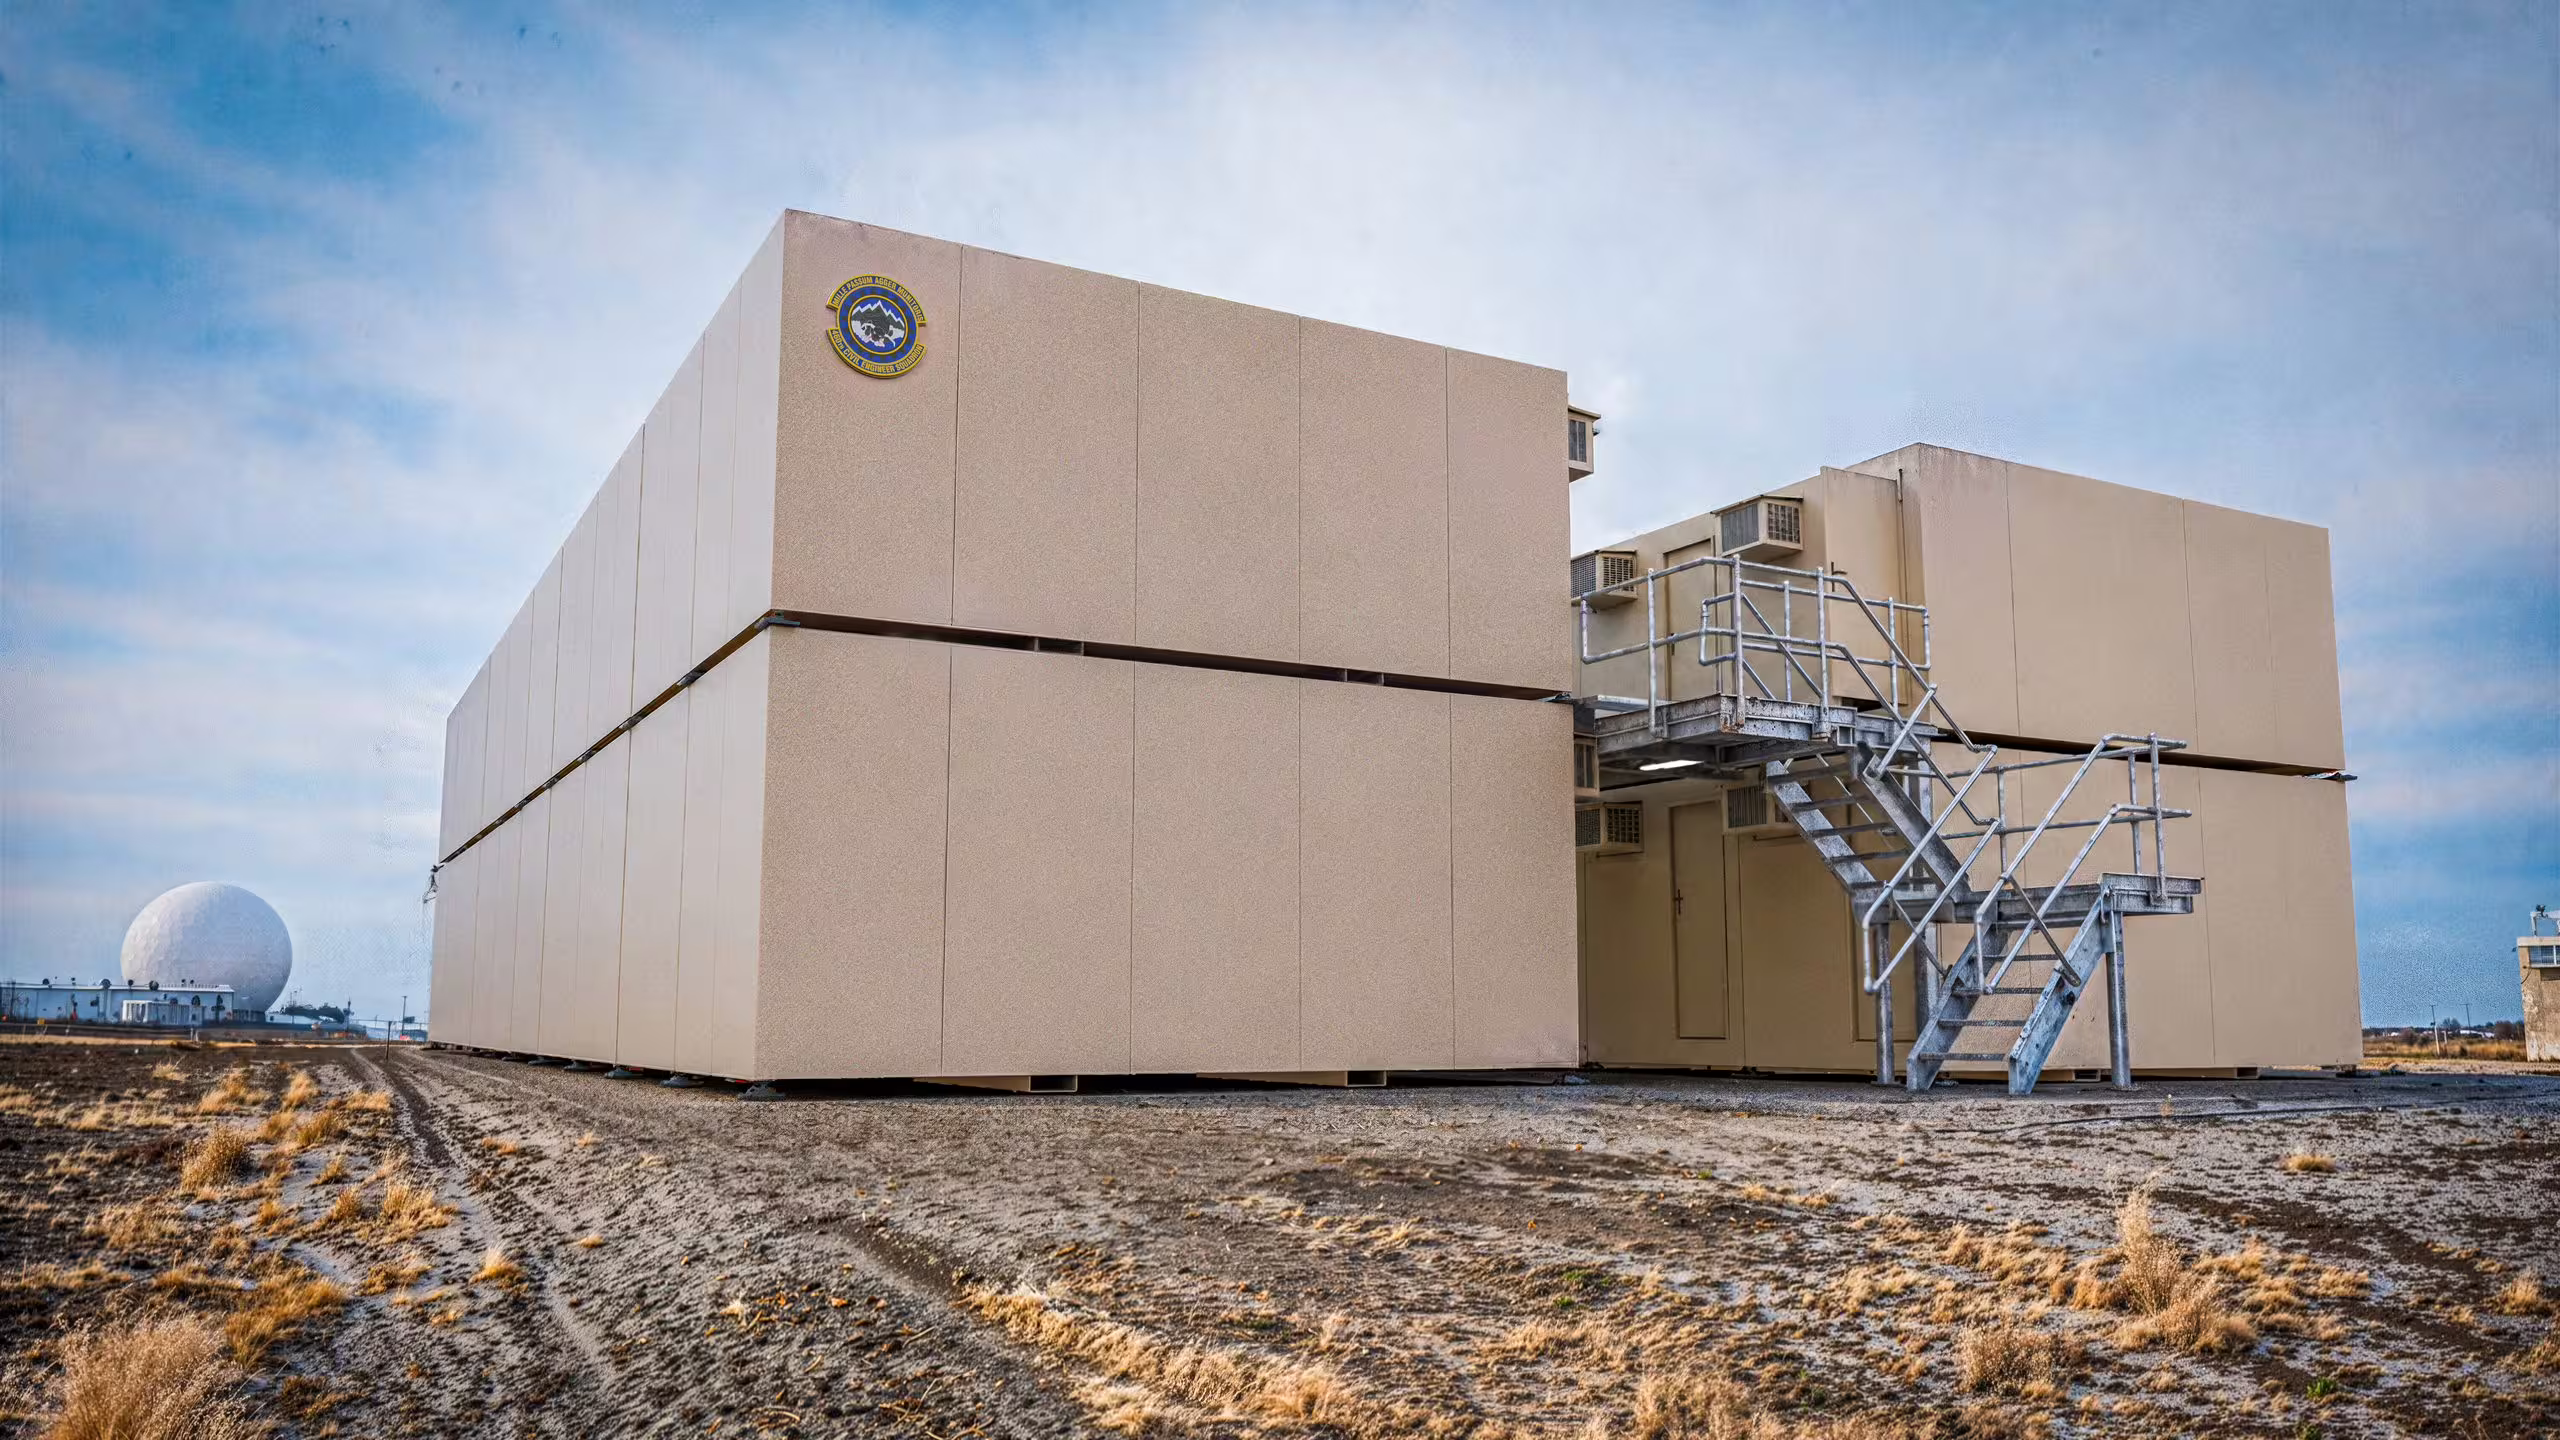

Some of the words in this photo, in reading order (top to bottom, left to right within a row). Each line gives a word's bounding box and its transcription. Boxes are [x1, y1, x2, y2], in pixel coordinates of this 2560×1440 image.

[843, 348, 860, 366] CIVIL
[861, 359, 896, 373] ENGINEER
[896, 344, 923, 371] SQUADRON
